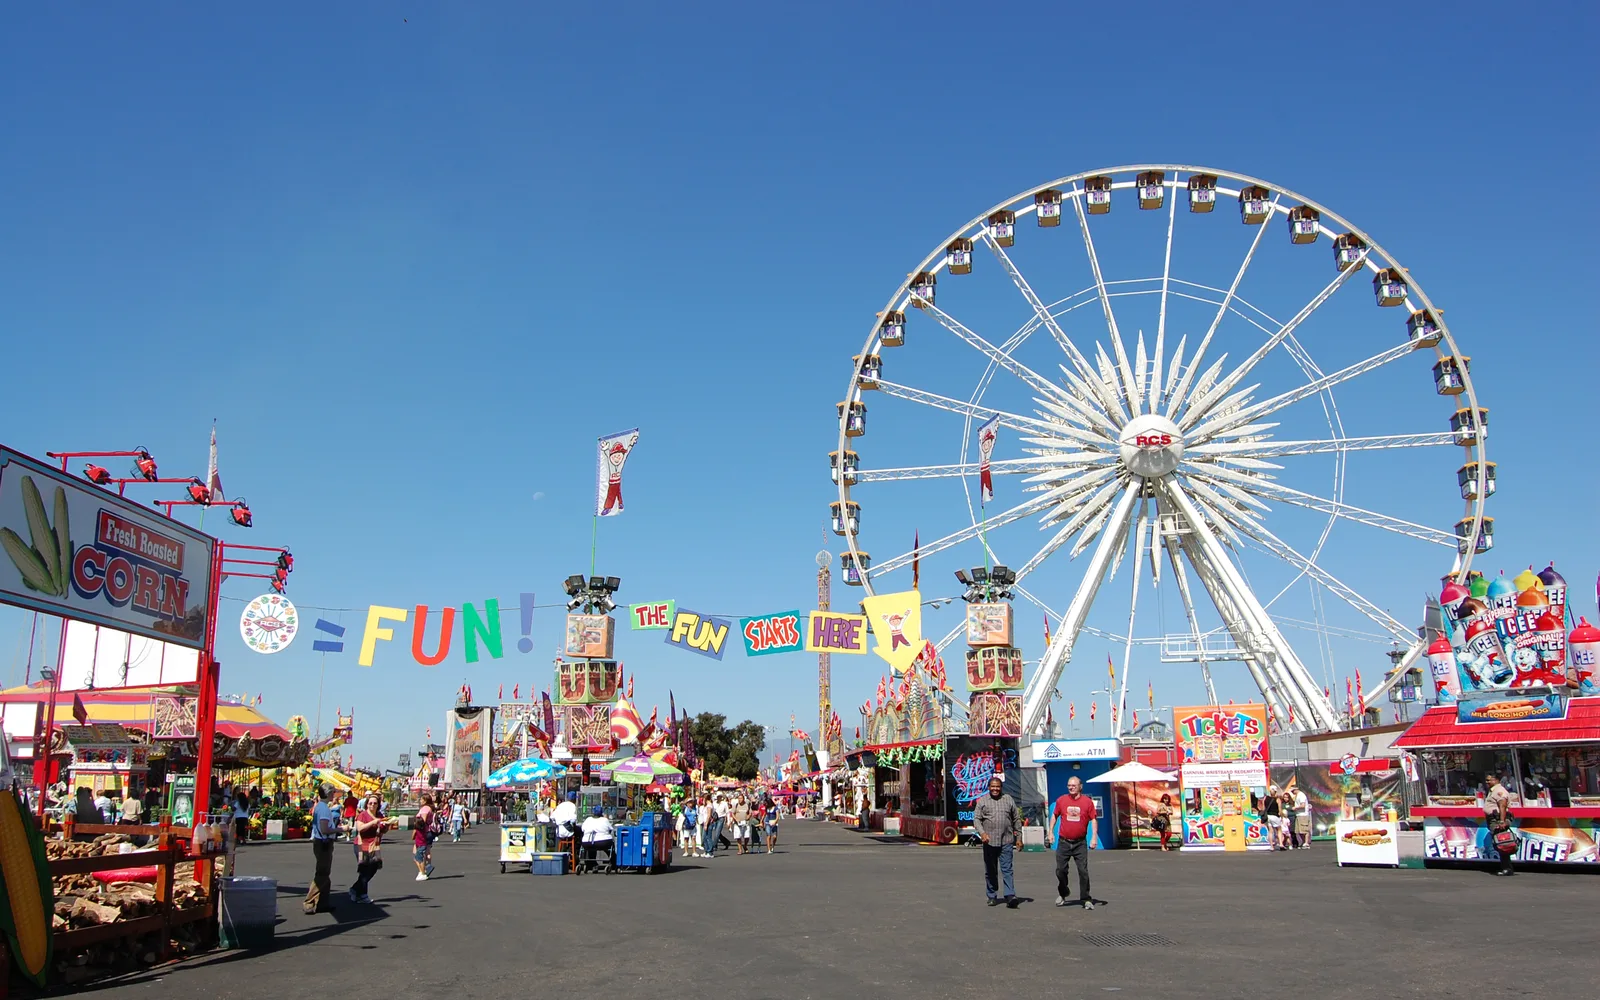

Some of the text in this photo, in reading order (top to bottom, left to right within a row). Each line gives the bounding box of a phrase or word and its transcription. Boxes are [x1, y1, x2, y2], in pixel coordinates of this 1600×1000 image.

[1136, 434, 1172, 446] RCS
[106, 518, 178, 564] Fresh Roasted
[73, 544, 190, 619] CORN
[635, 604, 669, 627] THE
[1484, 607, 1515, 627] EXPERIENCE
[1499, 614, 1537, 636] ICEE
[671, 612, 729, 655] FUN
[744, 615, 800, 652] STARTS
[813, 616, 862, 650] HERE
[1515, 631, 1533, 642] THE
[1470, 634, 1498, 656] ICEE
[1513, 710, 1529, 718] HOT
[1531, 707, 1549, 715] DOG
[1181, 712, 1259, 737] TICKETS
[1087, 748, 1106, 756] ATM
[177, 777, 194, 785] ATM
[1521, 837, 1568, 861] ICEE
